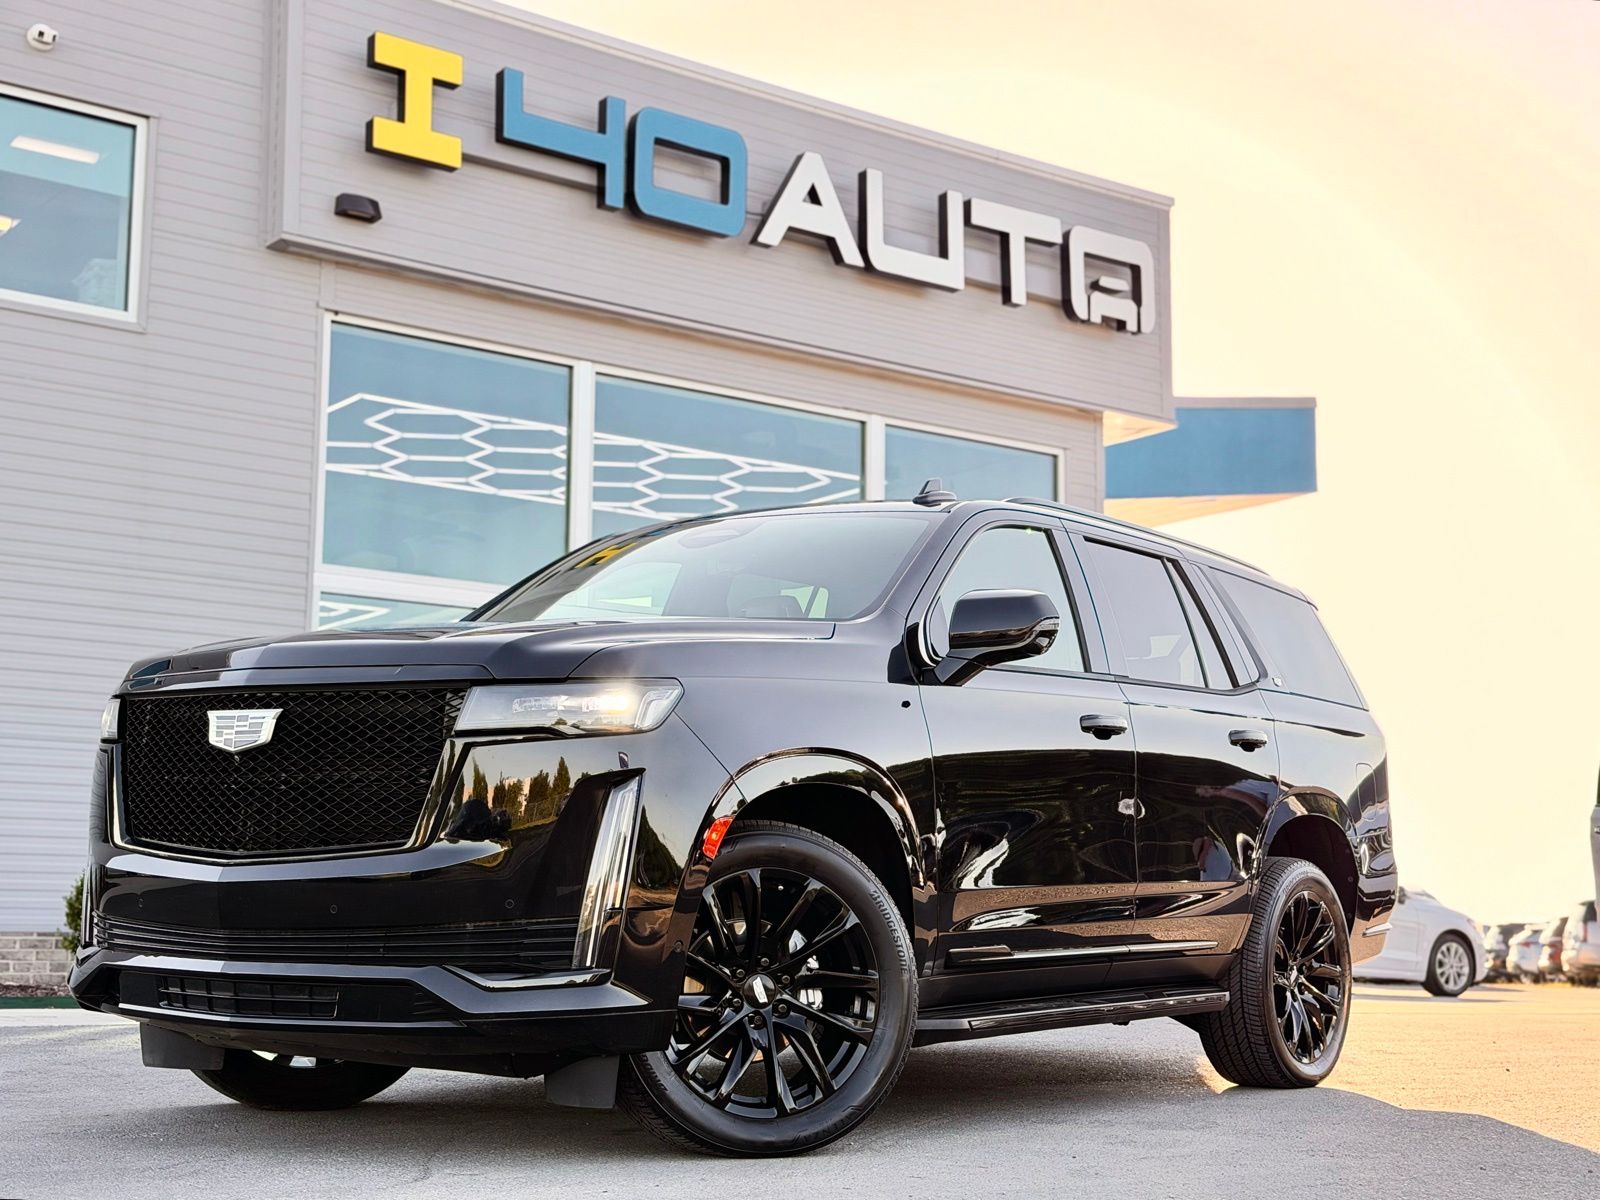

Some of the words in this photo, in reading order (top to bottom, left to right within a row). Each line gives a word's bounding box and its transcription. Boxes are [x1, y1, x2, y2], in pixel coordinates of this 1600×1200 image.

[366, 31, 463, 172] I
[496, 67, 747, 237] 40
[869, 889, 908, 976] BRIDGESTONE
